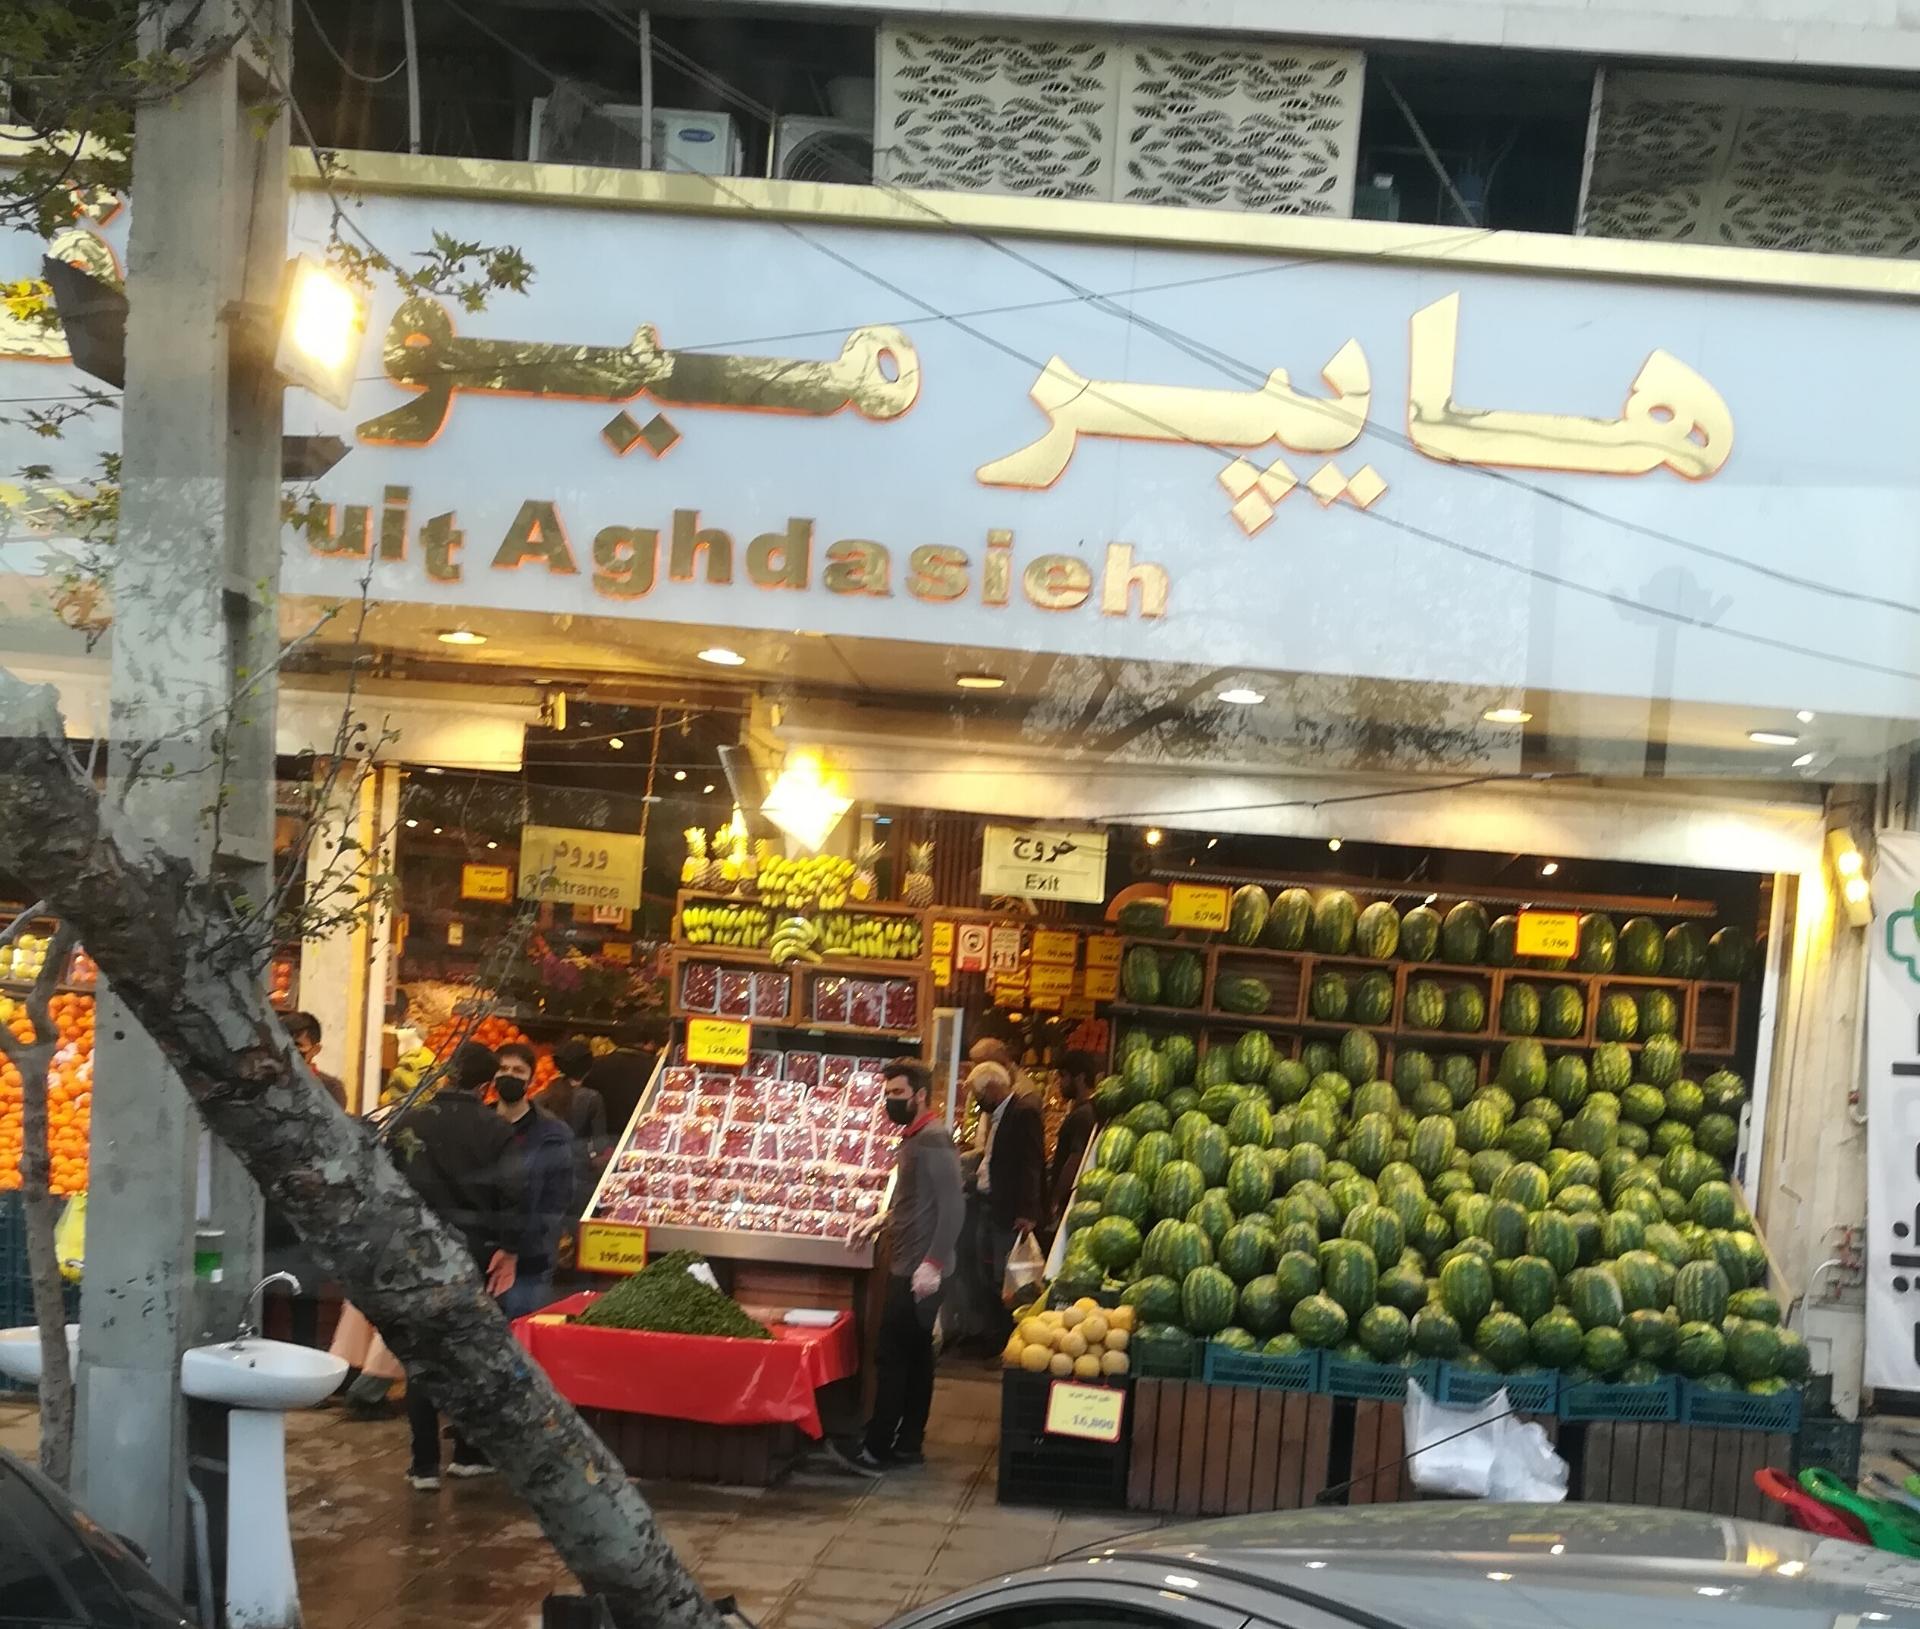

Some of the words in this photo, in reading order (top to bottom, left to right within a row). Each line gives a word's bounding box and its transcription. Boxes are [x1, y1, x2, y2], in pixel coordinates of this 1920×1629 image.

[356, 297, 920, 460] میو
[975, 290, 1735, 537] هایپر
[304, 484, 467, 584] uit
[490, 498, 1170, 619] Aghdasieh
[553, 840, 609, 871] ورود
[1012, 833, 1078, 863] خروج
[1025, 873, 1060, 892] Exit
